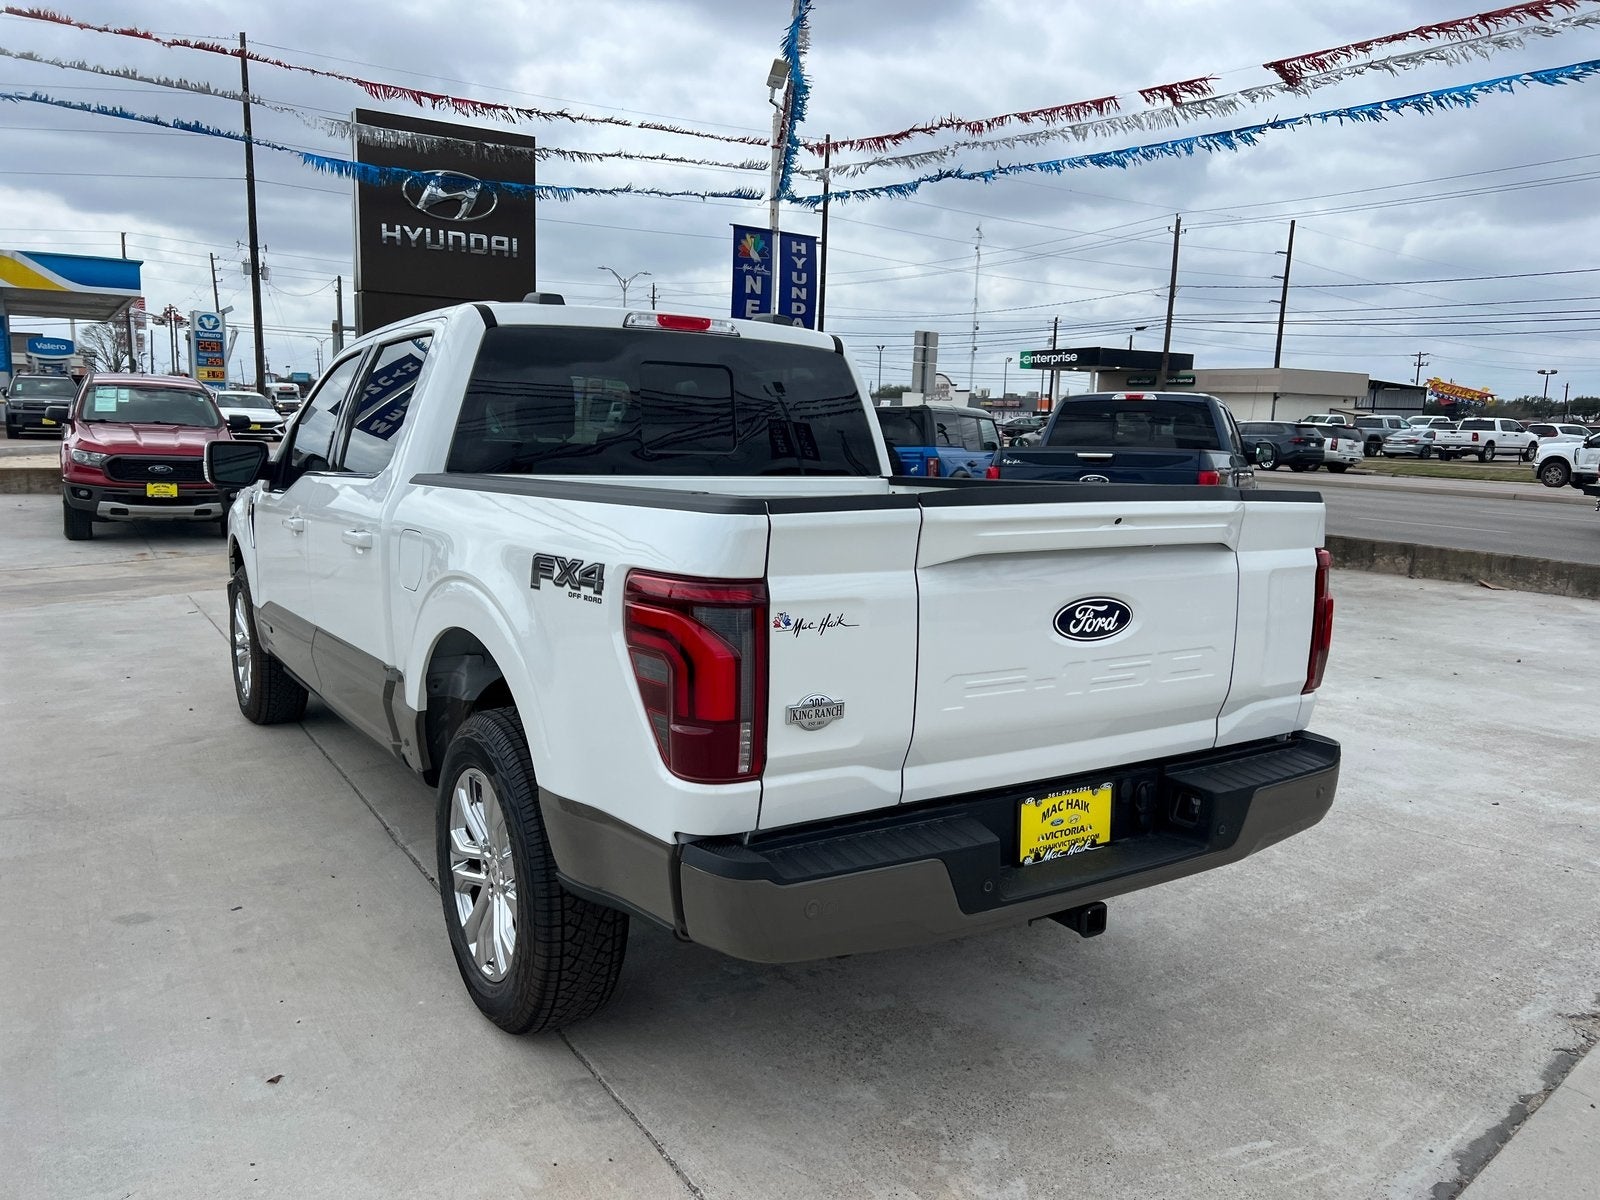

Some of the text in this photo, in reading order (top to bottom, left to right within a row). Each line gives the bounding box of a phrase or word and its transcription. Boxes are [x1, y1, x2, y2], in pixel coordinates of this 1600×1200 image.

[381, 223, 518, 258] HYUNDAI
[36, 342, 66, 351] Valero
[1022, 352, 1078, 365] enterprise
[1427, 377, 1482, 401] Premier
[530, 552, 606, 596] FX4
[568, 591, 603, 605] OFF ROAD
[791, 613, 860, 639] Mac Haik
[1068, 603, 1121, 634] Ford
[792, 704, 843, 722] KING RANCH
[1041, 799, 1090, 823] MAC HAIK
[1045, 825, 1085, 840] VICTORIA
[1042, 838, 1105, 862] Mac Haik
